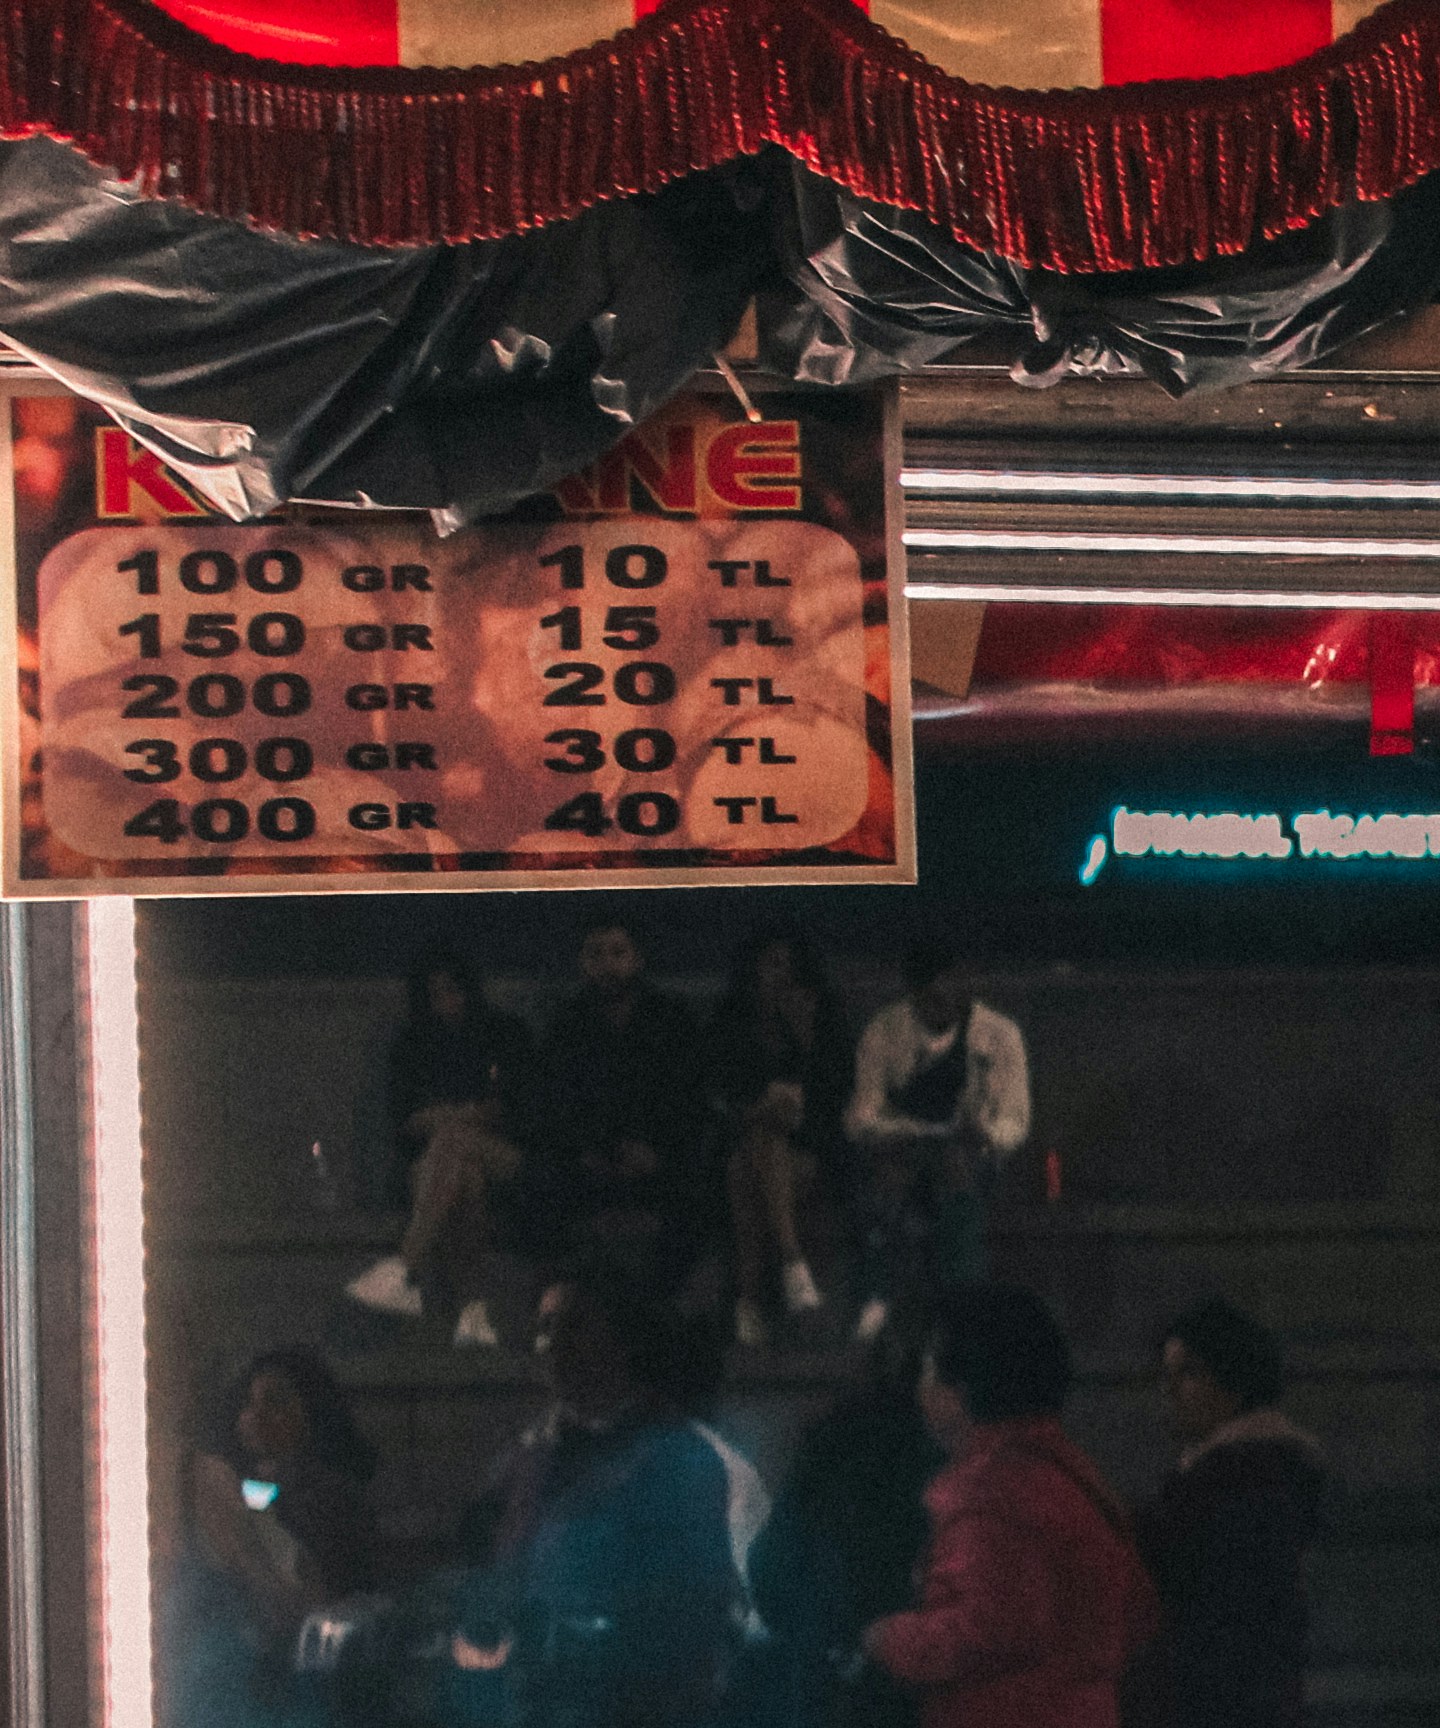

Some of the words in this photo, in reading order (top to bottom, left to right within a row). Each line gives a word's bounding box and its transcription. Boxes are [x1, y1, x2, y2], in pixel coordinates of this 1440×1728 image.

[117, 549, 303, 595] 100
[341, 563, 433, 593] GR
[539, 544, 668, 589] 10
[707, 560, 792, 588] TL
[118, 611, 306, 659] 150
[343, 623, 435, 652] GR
[540, 605, 660, 651] 15
[708, 618, 794, 647] TL
[120, 672, 312, 719] 200
[344, 682, 437, 711] GR
[543, 661, 676, 706] 20
[710, 677, 795, 705] TL
[123, 736, 314, 784] 300
[346, 742, 439, 772] GR
[543, 728, 677, 773] 30
[711, 737, 797, 765] TL
[123, 796, 316, 844] 400
[348, 802, 438, 832] GR
[544, 791, 681, 837] 40
[713, 796, 799, 825] TL
